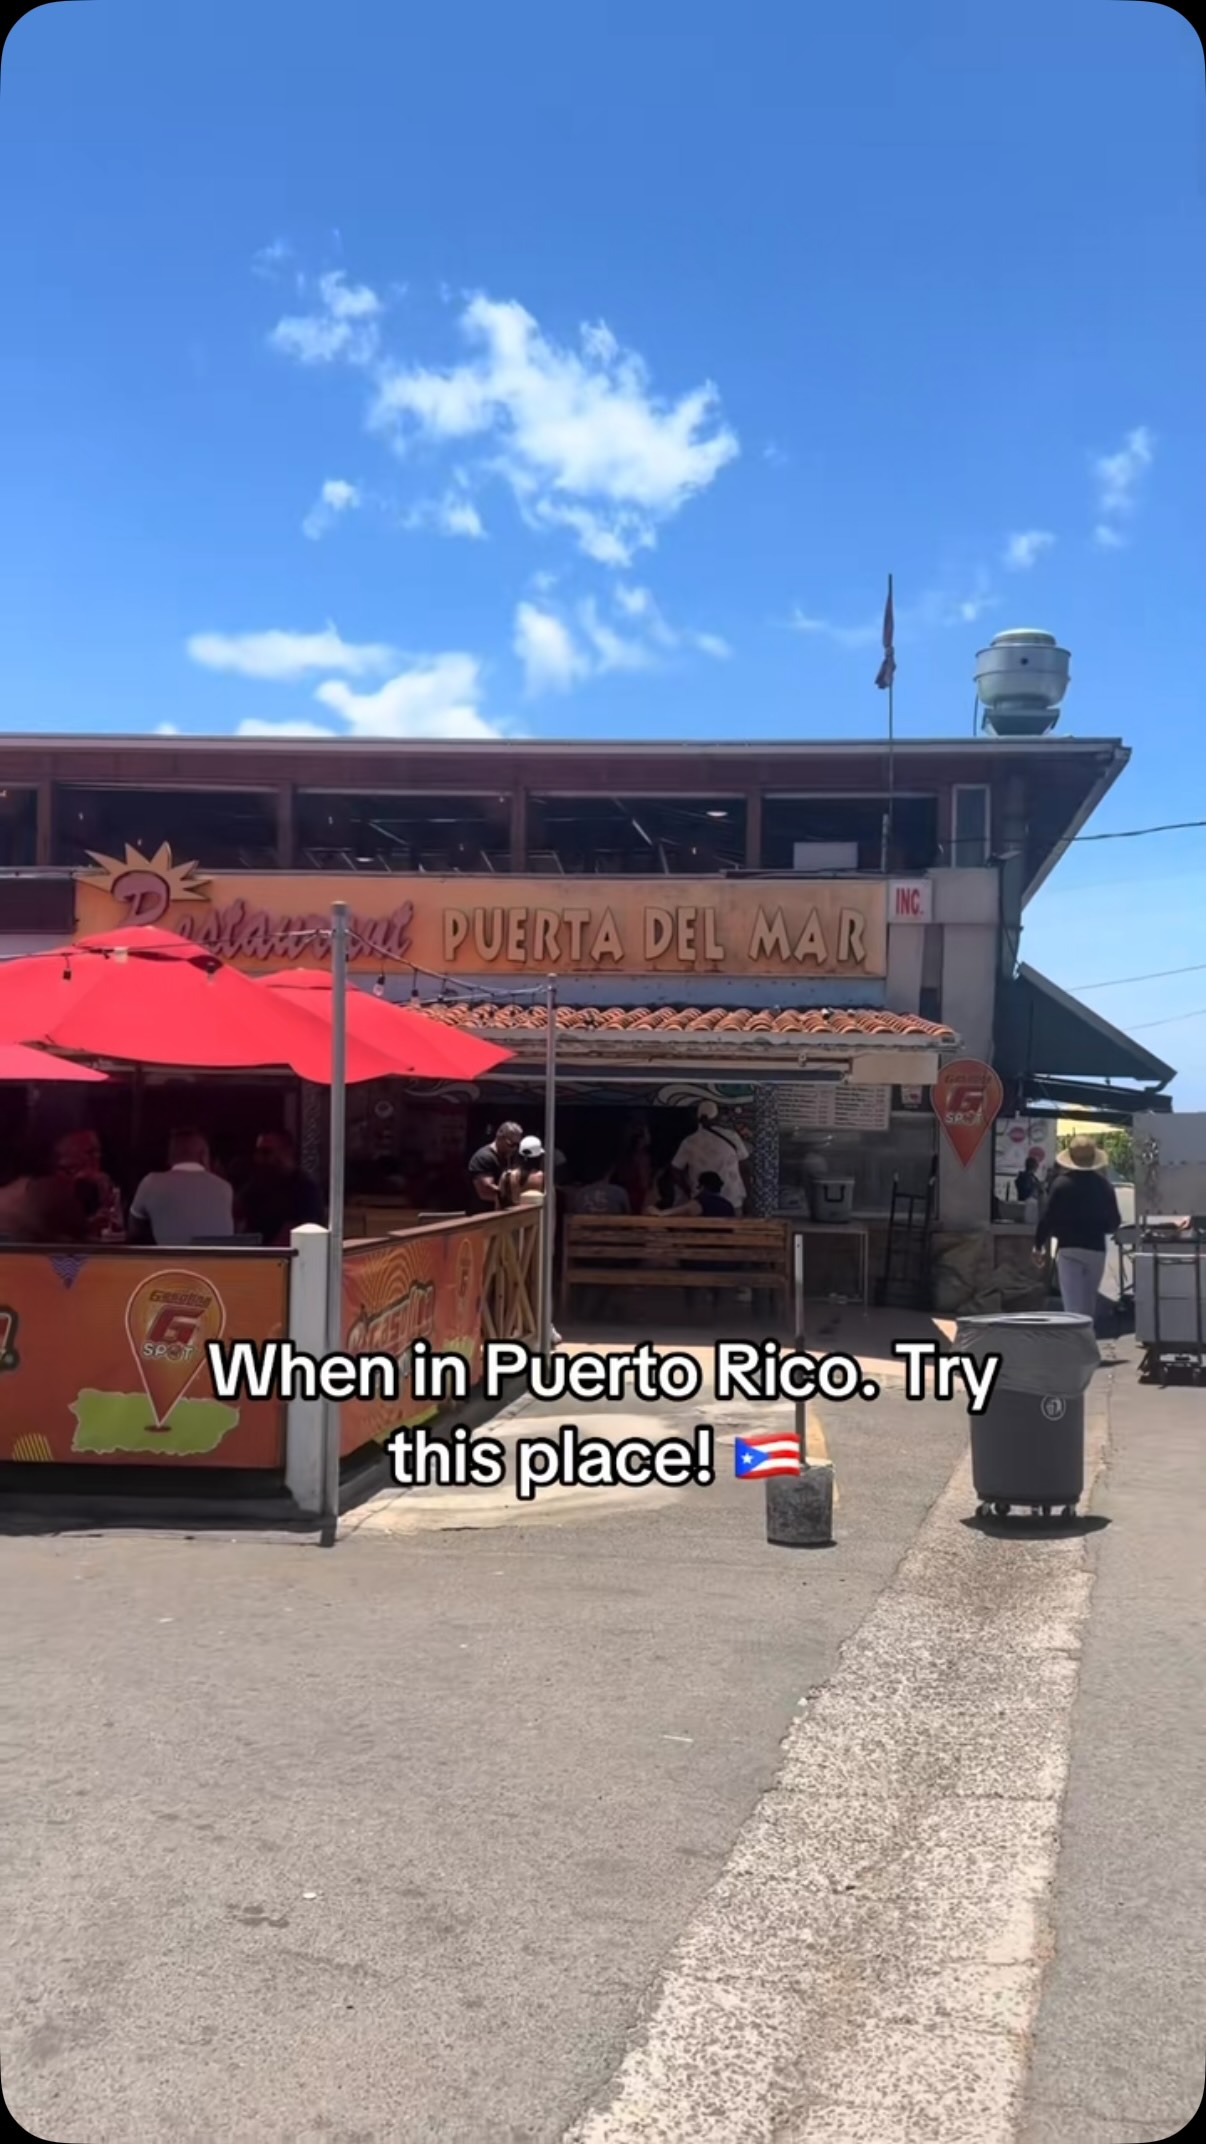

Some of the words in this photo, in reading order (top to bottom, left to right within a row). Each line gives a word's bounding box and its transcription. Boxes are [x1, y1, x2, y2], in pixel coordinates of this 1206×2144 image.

[895, 887, 924, 915] INC.
[442, 906, 624, 963] PUERTA
[643, 905, 725, 963] DEL
[747, 905, 869, 963] MAR
